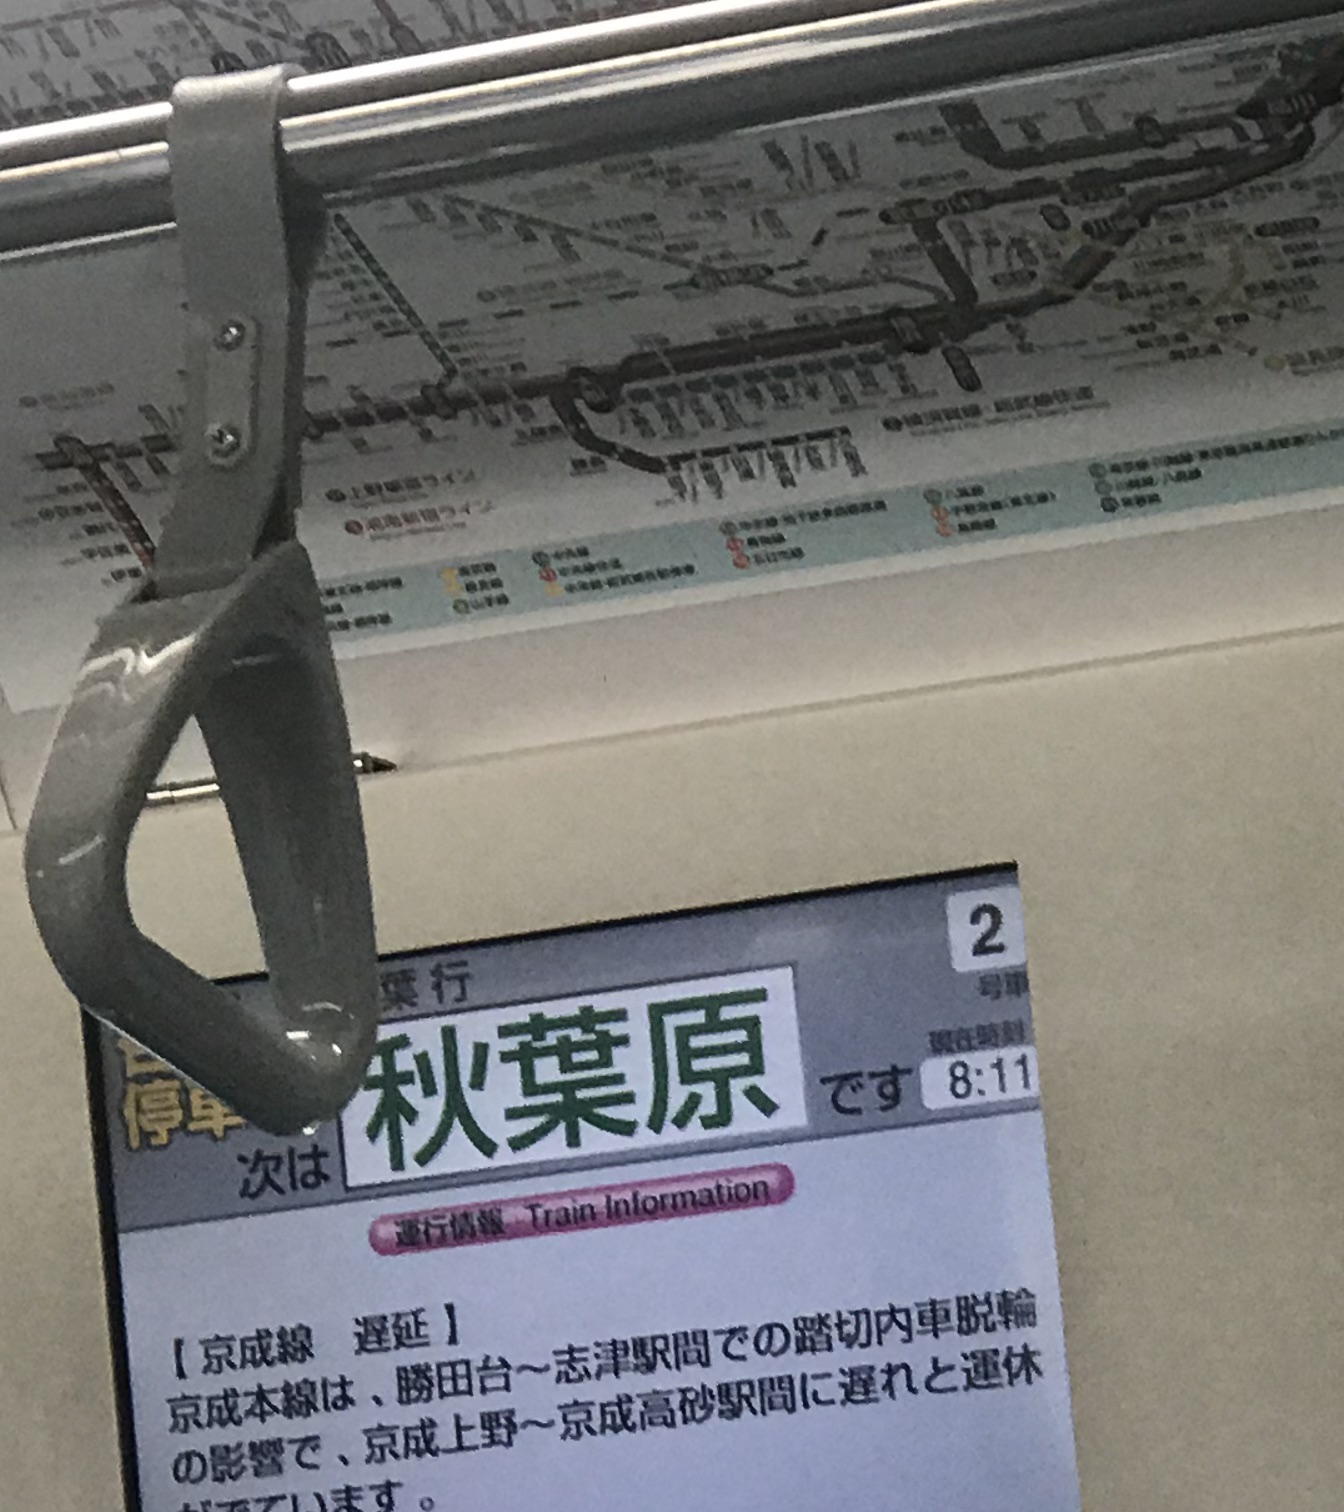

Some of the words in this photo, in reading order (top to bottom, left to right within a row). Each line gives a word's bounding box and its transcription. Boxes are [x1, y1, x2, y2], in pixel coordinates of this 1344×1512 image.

[969, 903, 1006, 957] 2
[236, 1143, 332, 1199] 次は
[363, 986, 781, 1172] 秋葉原
[819, 1064, 914, 1116] です
[948, 1053, 1031, 1100] 8:11
[394, 1207, 507, 1248] 運行情報
[524, 1200, 597, 1232] Train
[605, 1178, 770, 1221] Information
